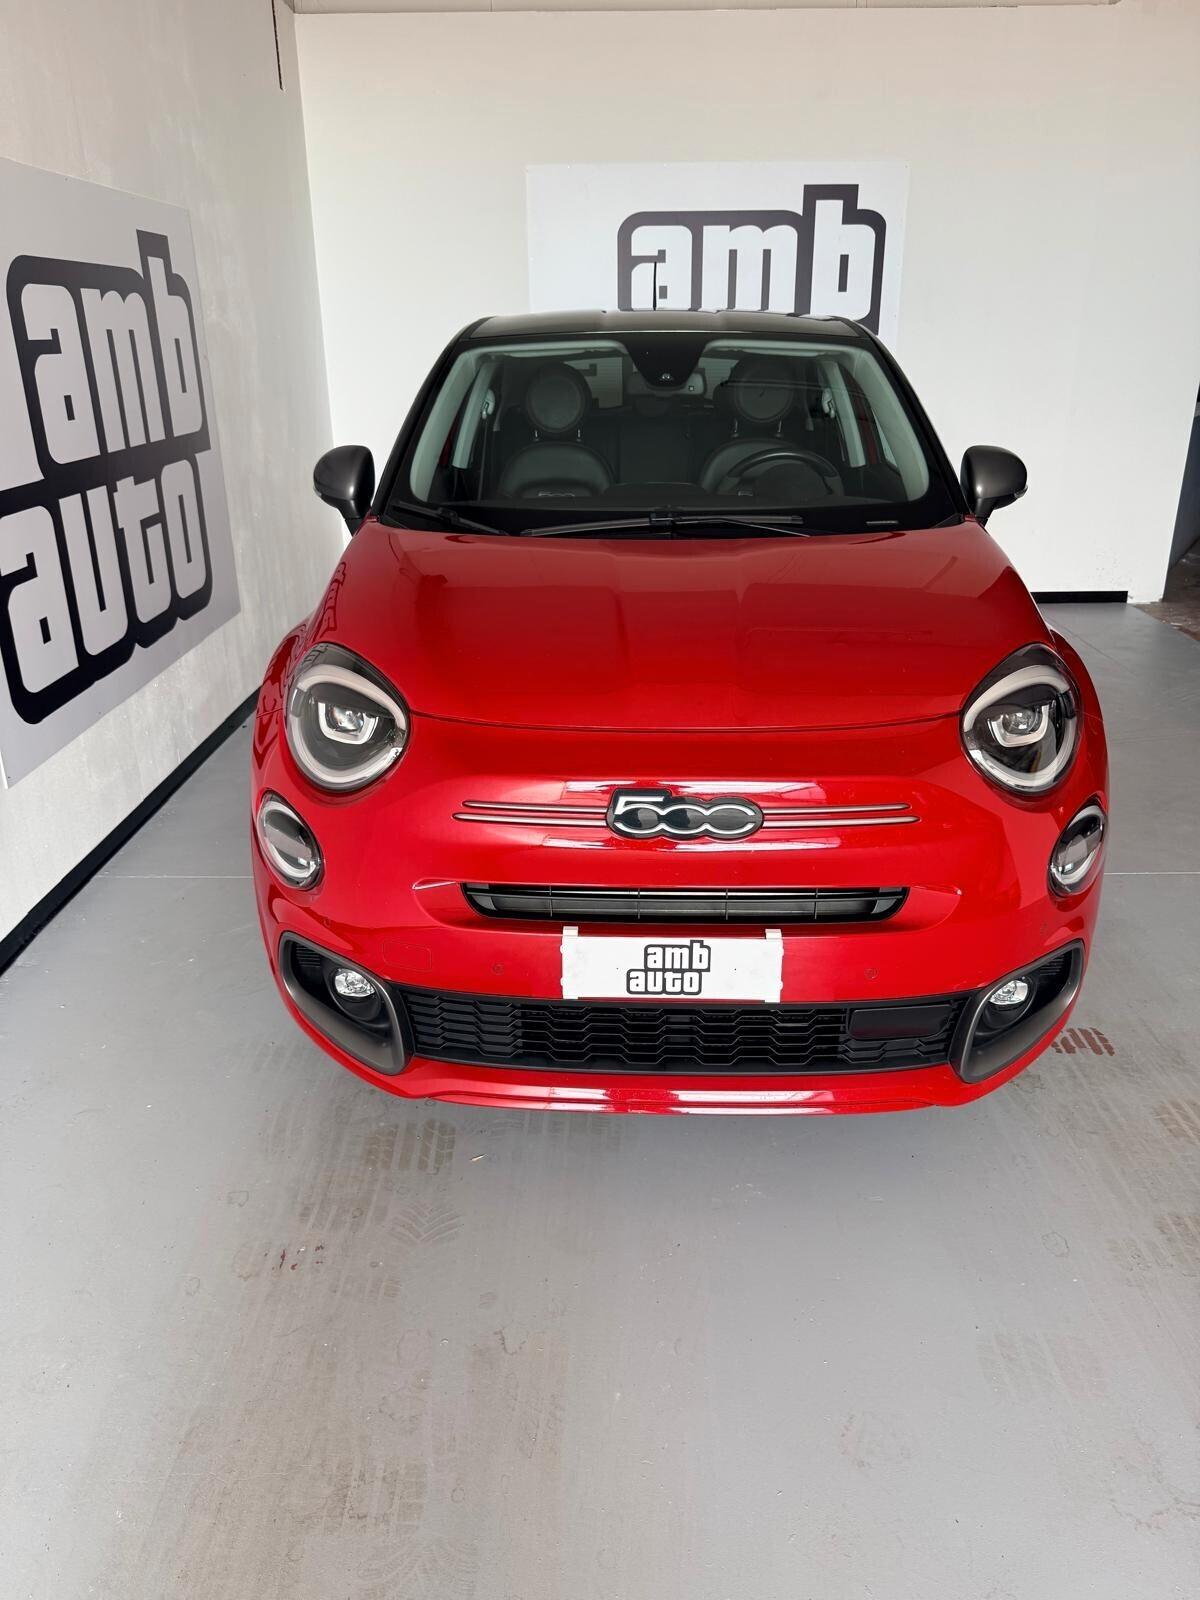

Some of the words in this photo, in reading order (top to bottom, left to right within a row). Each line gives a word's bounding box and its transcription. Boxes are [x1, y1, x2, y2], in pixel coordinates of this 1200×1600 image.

[622, 190, 882, 318] amb
[12, 240, 206, 466] amb
[0, 459, 210, 705] auto
[611, 793, 759, 836] 500
[628, 970, 701, 994] auto
[645, 941, 710, 970] amb
